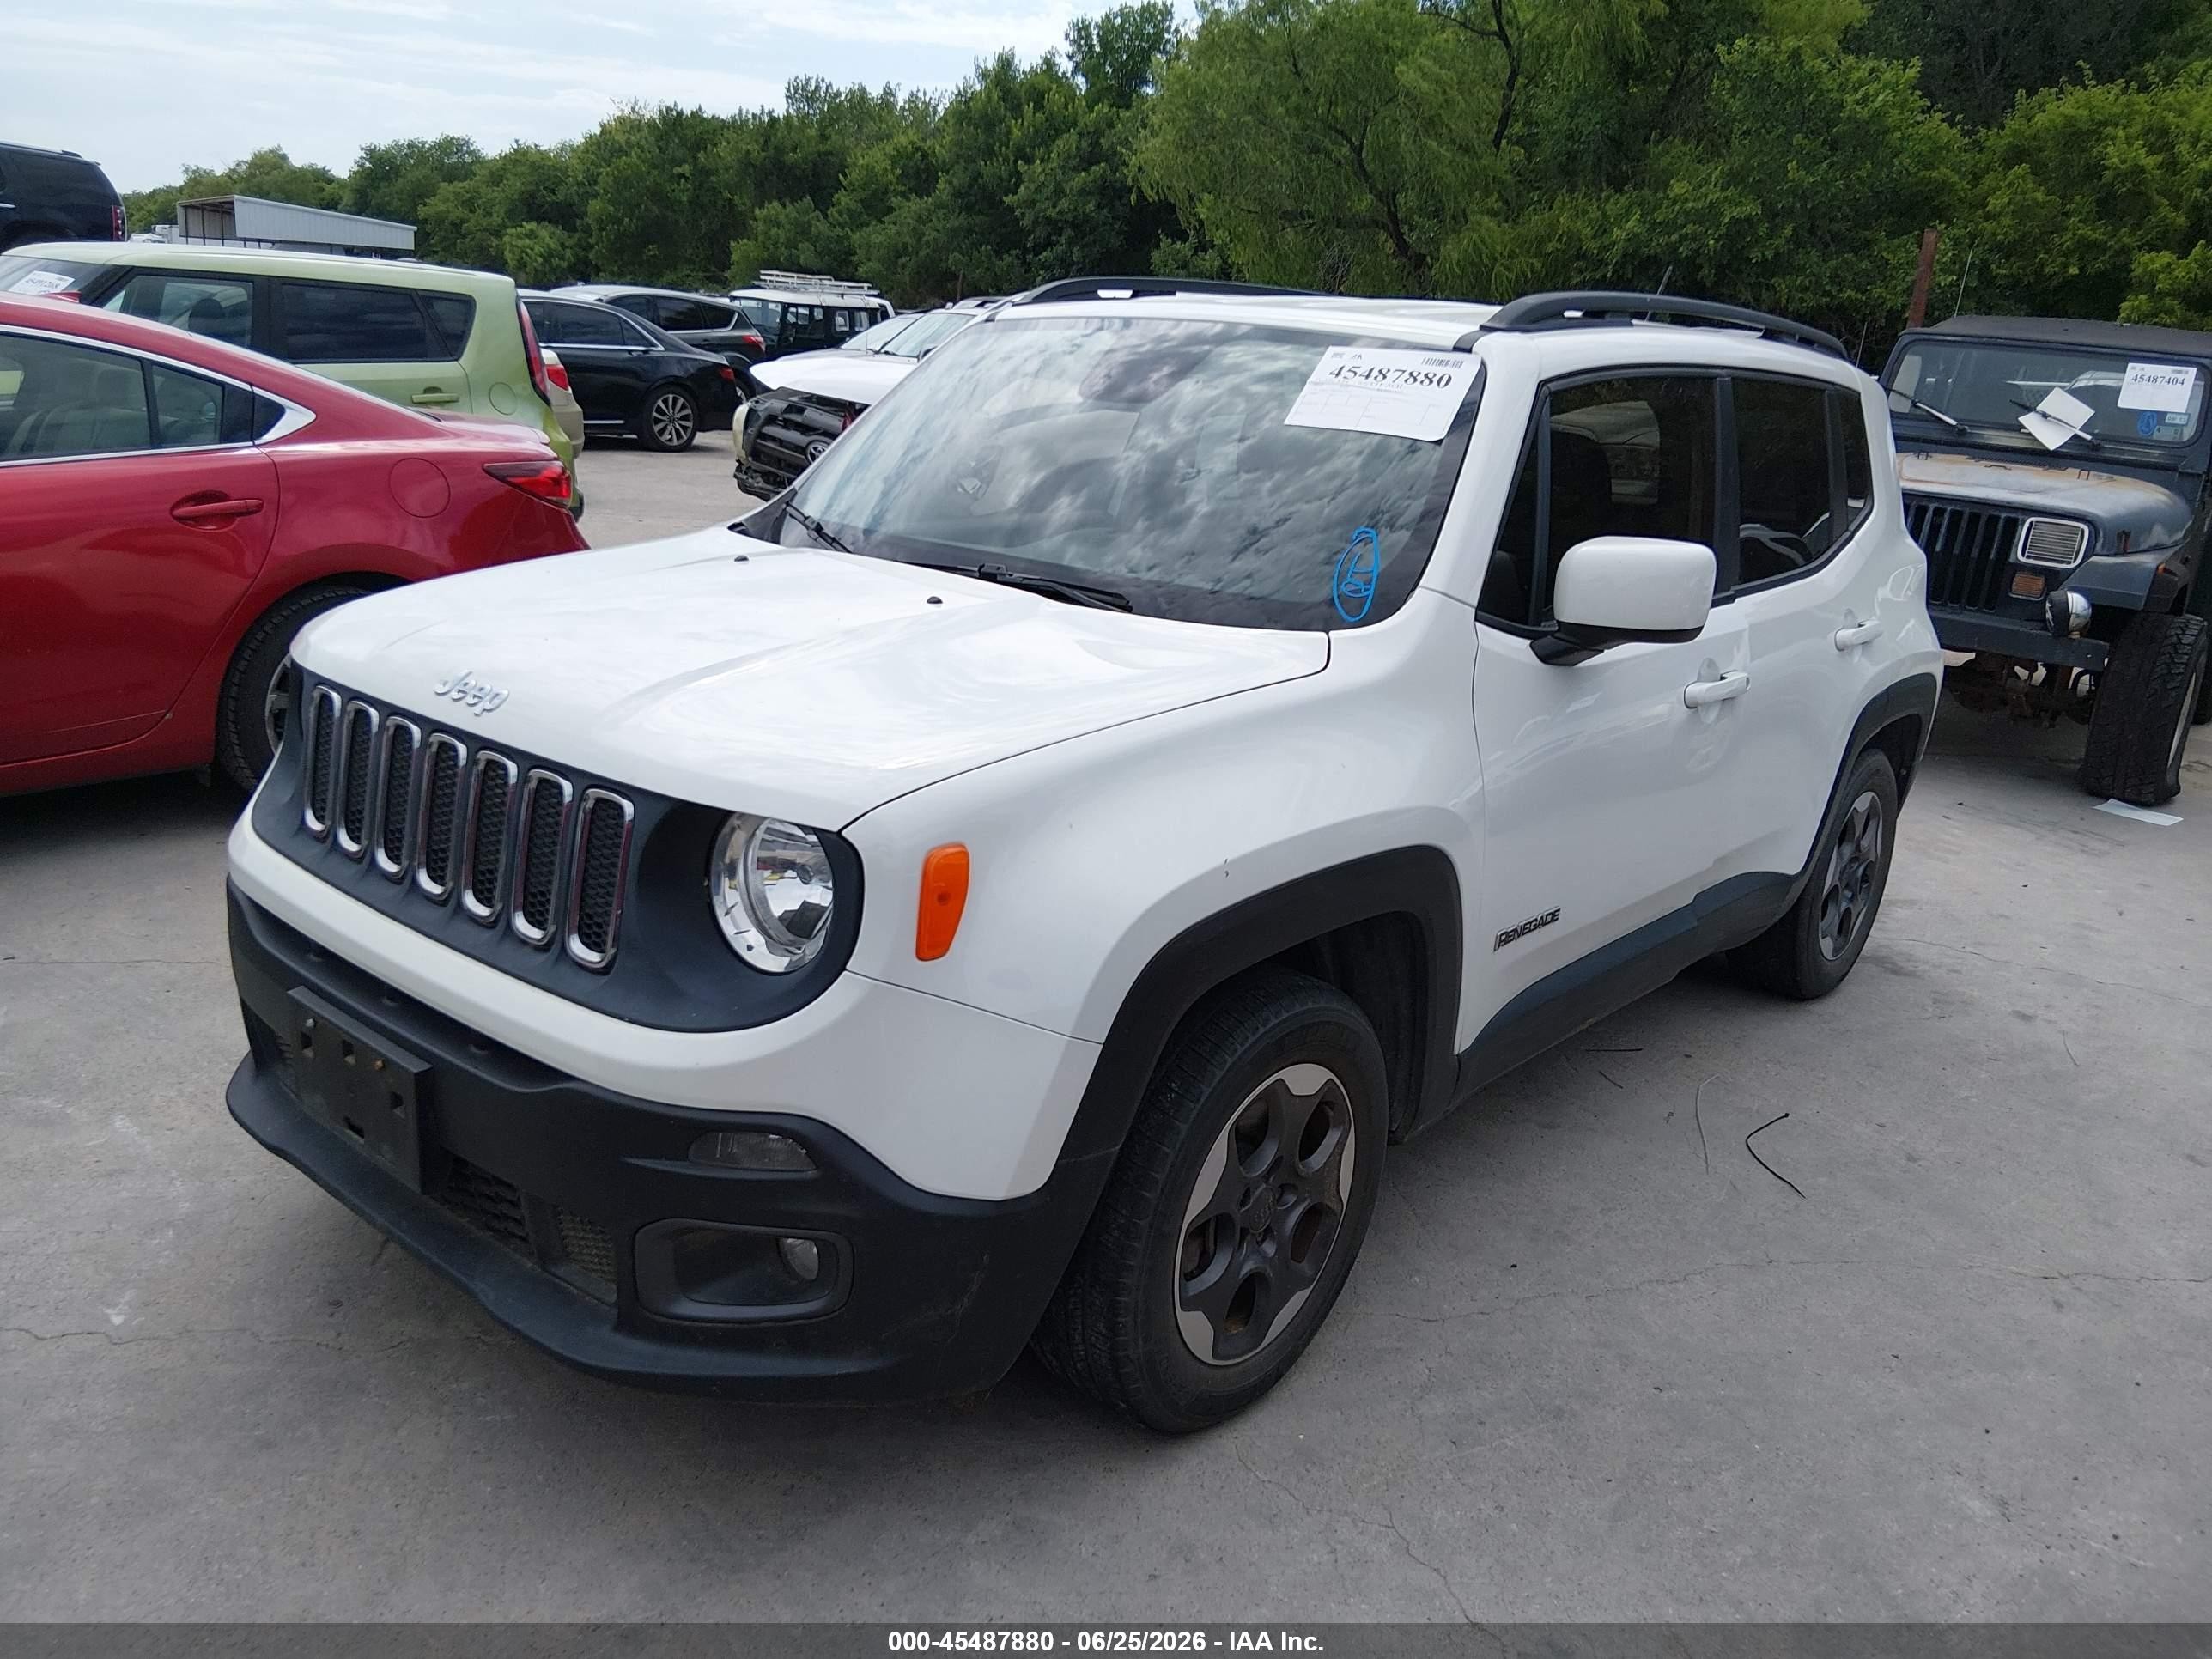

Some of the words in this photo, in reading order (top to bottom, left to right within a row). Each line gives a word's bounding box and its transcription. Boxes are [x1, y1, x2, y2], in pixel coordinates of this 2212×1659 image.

[1328, 365, 1453, 389] 45487880
[2131, 374, 2185, 386] 45487404
[434, 669, 510, 717] Jeep
[1493, 906, 1561, 951] RENEGADE
